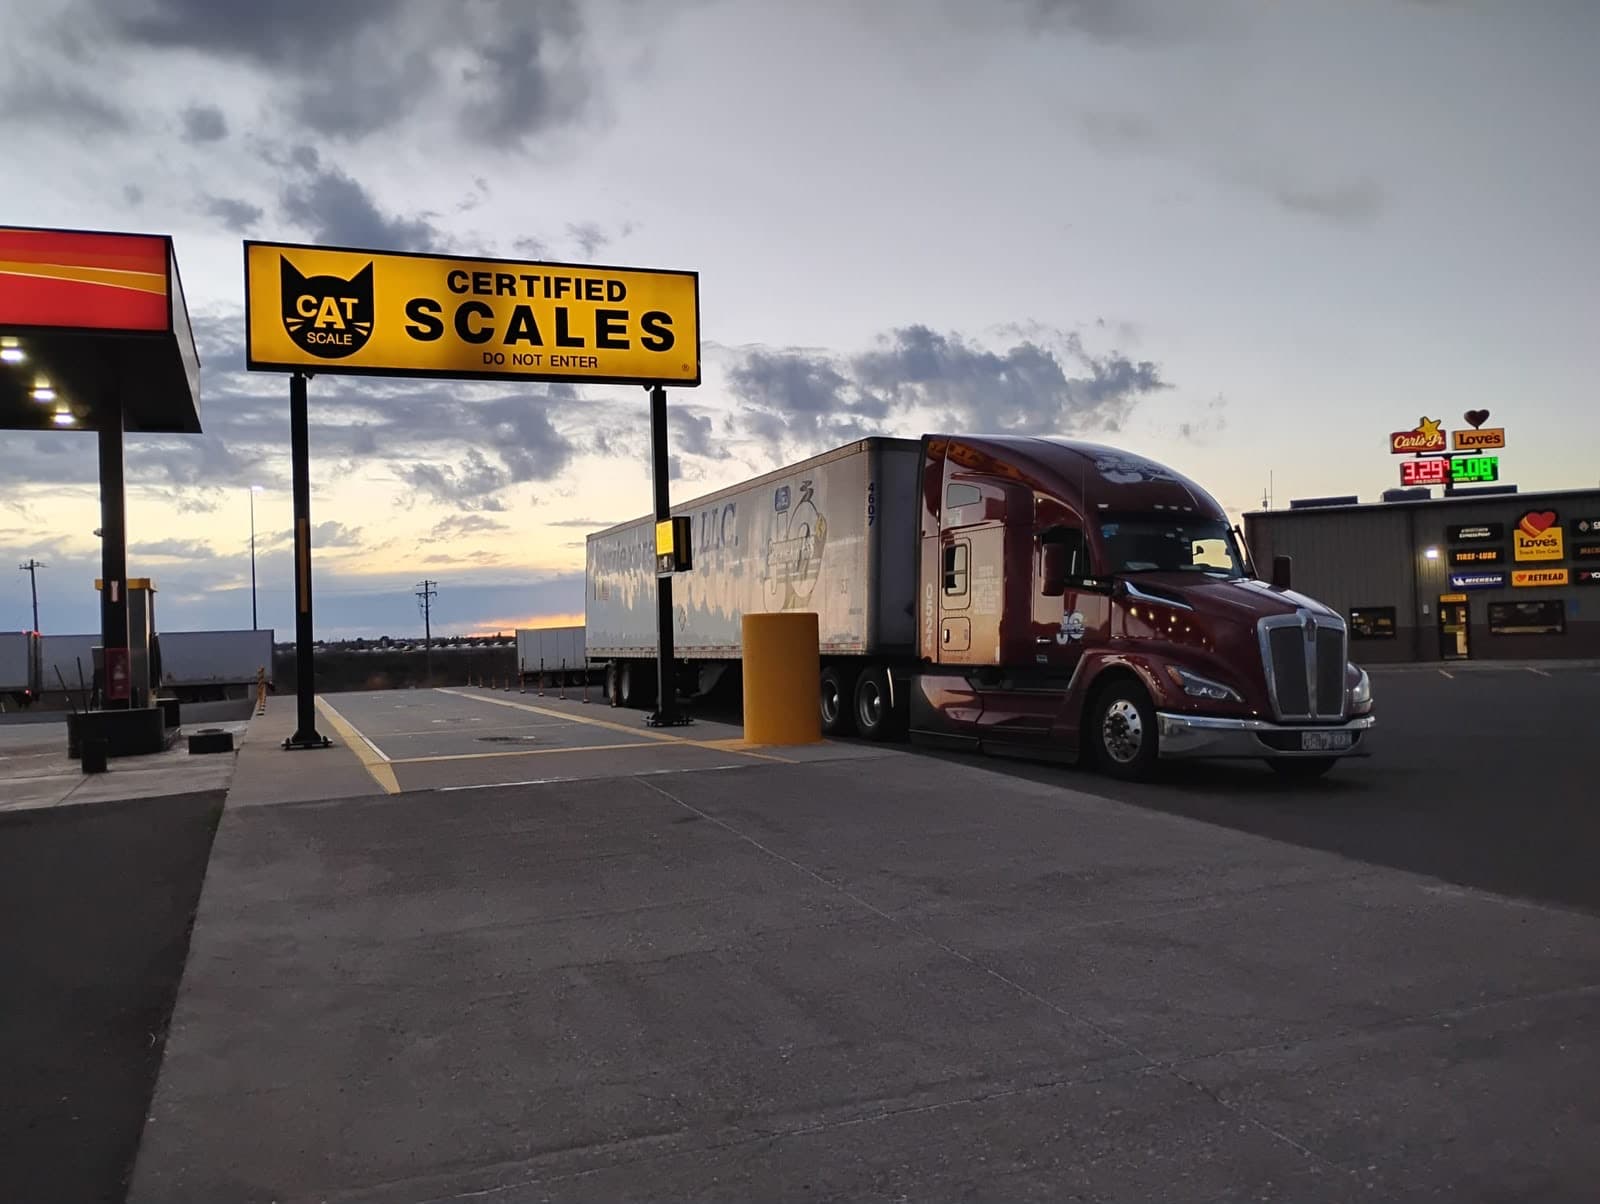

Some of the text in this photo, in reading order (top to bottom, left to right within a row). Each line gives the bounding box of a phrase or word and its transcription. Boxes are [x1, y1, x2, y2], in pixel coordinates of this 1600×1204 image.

[446, 269, 627, 303] CERTIFIED
[296, 294, 359, 329] CAT
[404, 297, 675, 352] SCALES
[306, 331, 353, 346] SCALE
[482, 351, 599, 369] DO NOT ENTER
[1393, 434, 1426, 449] Carl's
[867, 480, 875, 528] 4607
[1527, 572, 1564, 583] RETREAD
